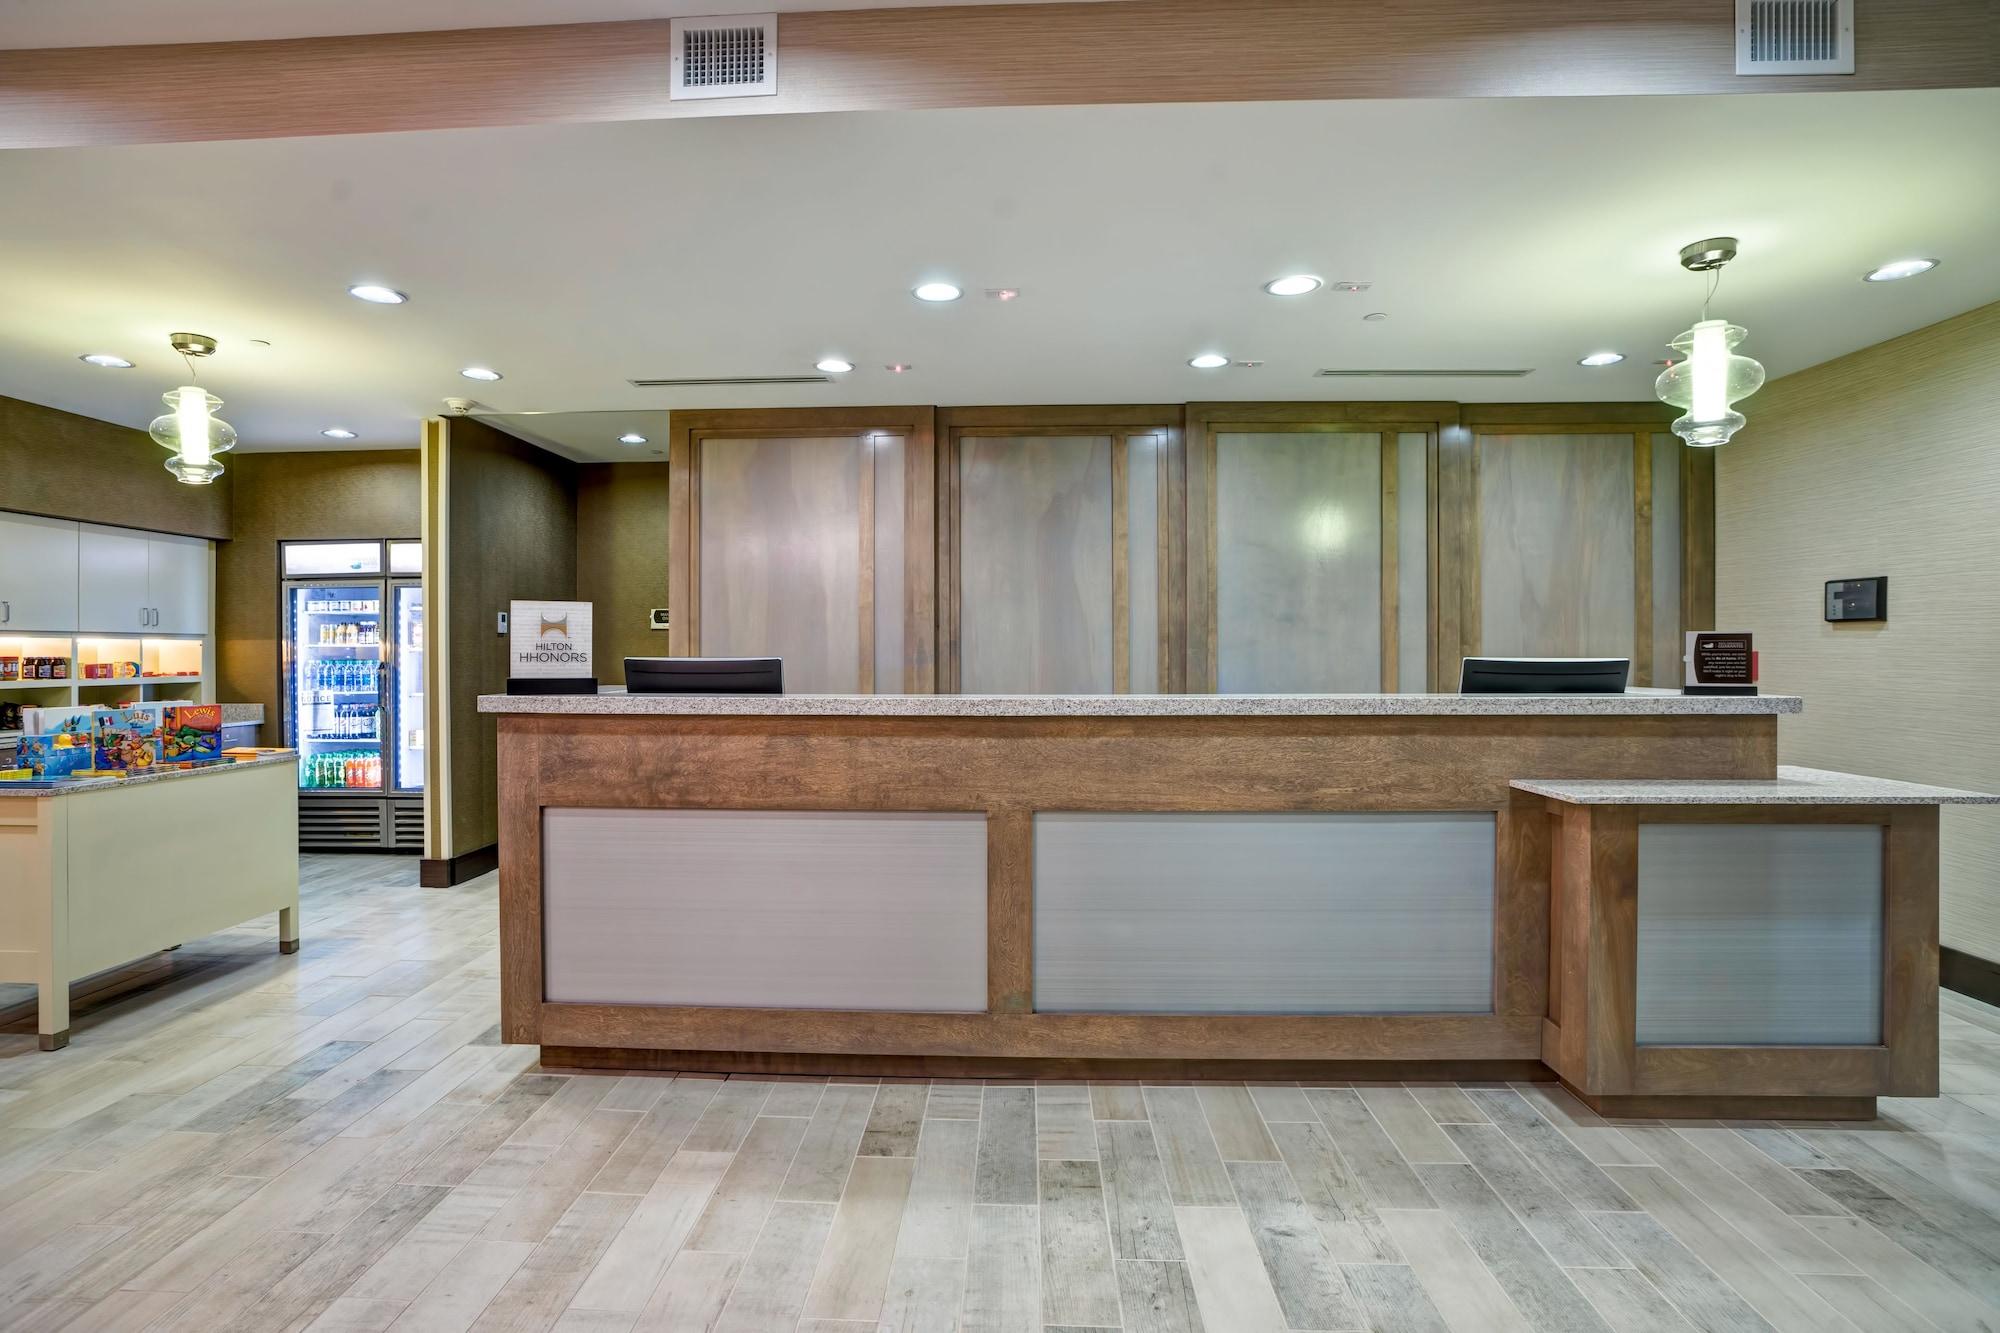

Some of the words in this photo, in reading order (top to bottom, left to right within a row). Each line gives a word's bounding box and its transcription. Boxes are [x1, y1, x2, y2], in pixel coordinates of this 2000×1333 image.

[535, 642, 573, 651] HILTON
[519, 652, 588, 663] HHONORS
[184, 705, 216, 719] Lewis
